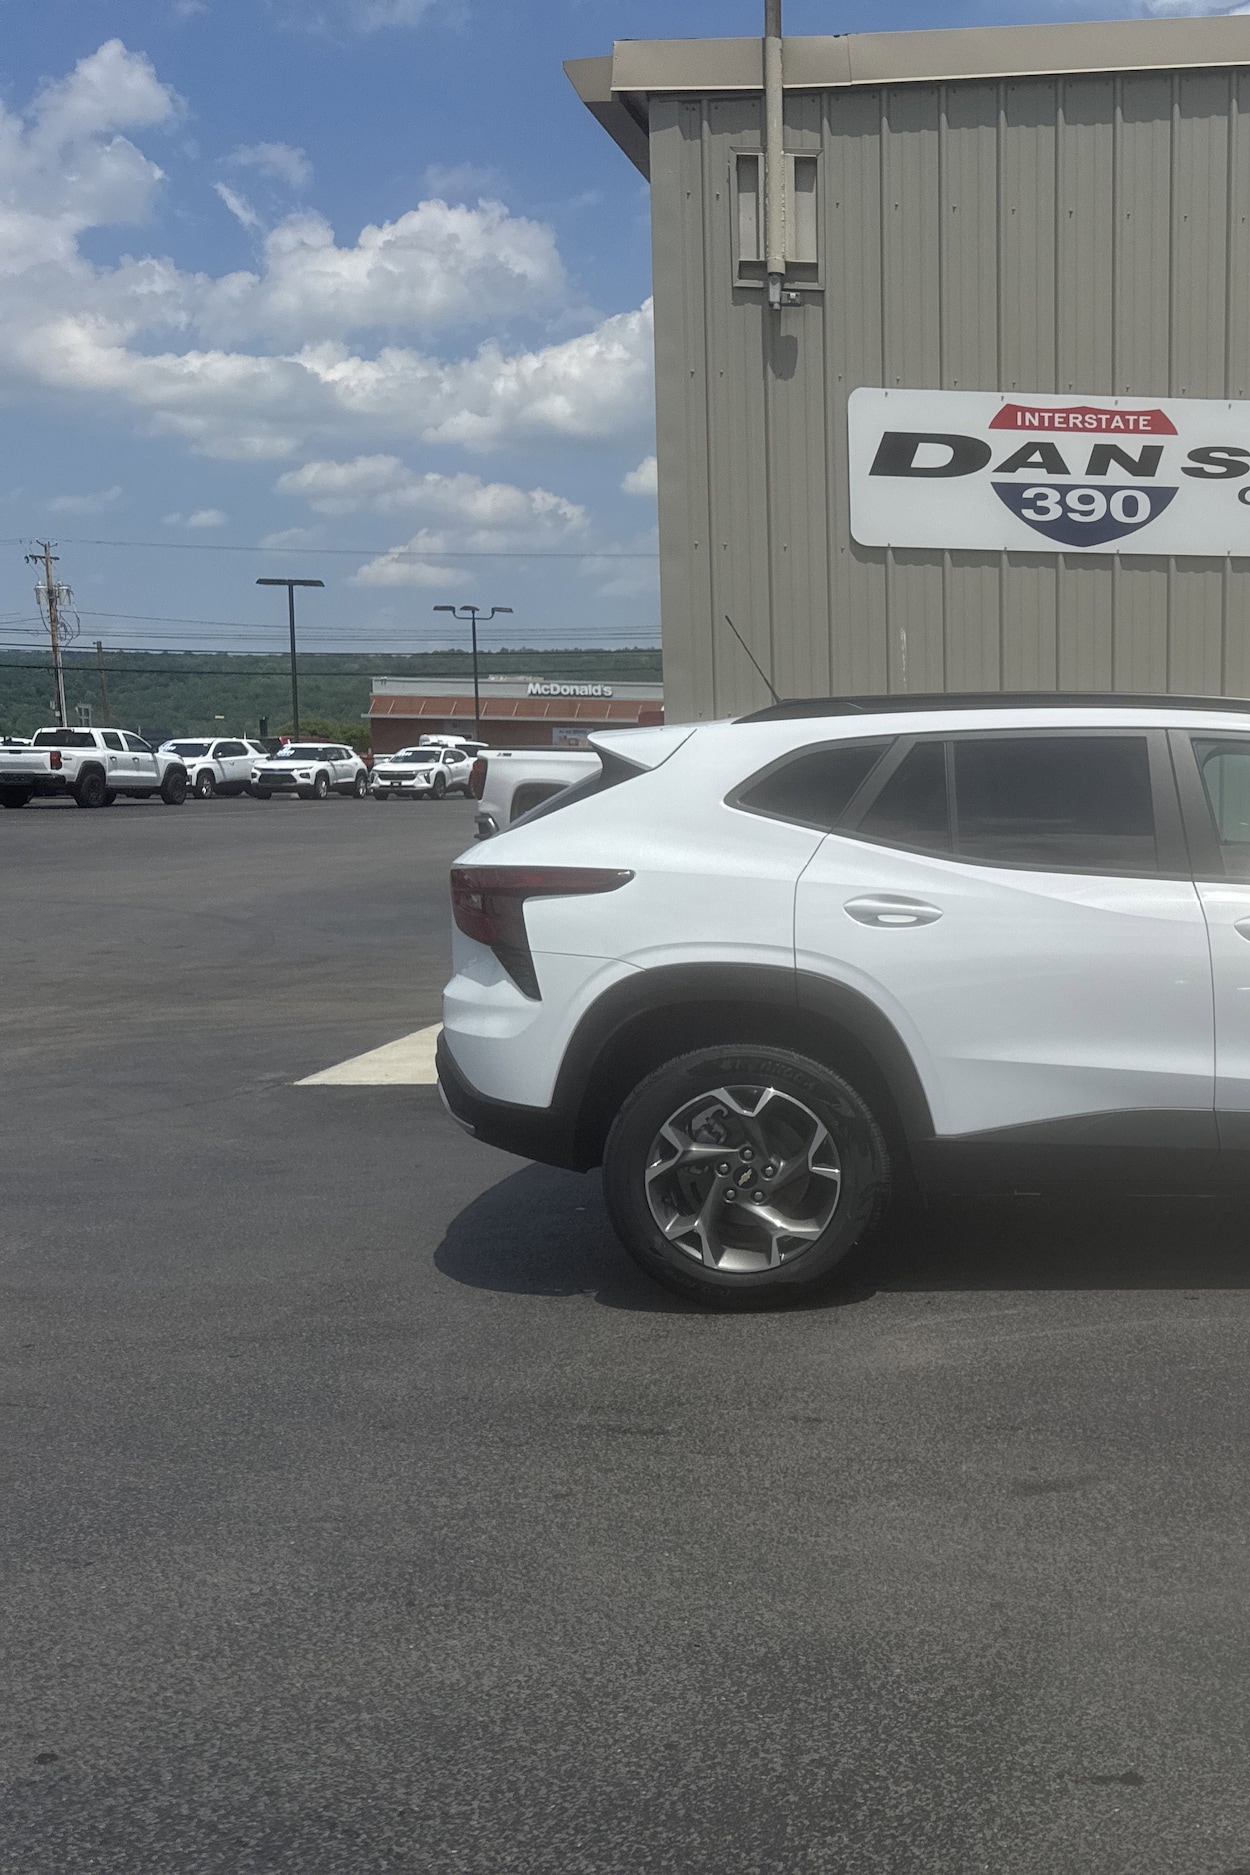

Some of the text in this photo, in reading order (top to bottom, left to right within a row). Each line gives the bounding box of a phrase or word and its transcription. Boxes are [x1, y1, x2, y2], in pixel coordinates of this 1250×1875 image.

[1016, 411, 1152, 430] INTERSTATE
[1021, 486, 1152, 523] 390
[528, 682, 613, 696] McDonald's
